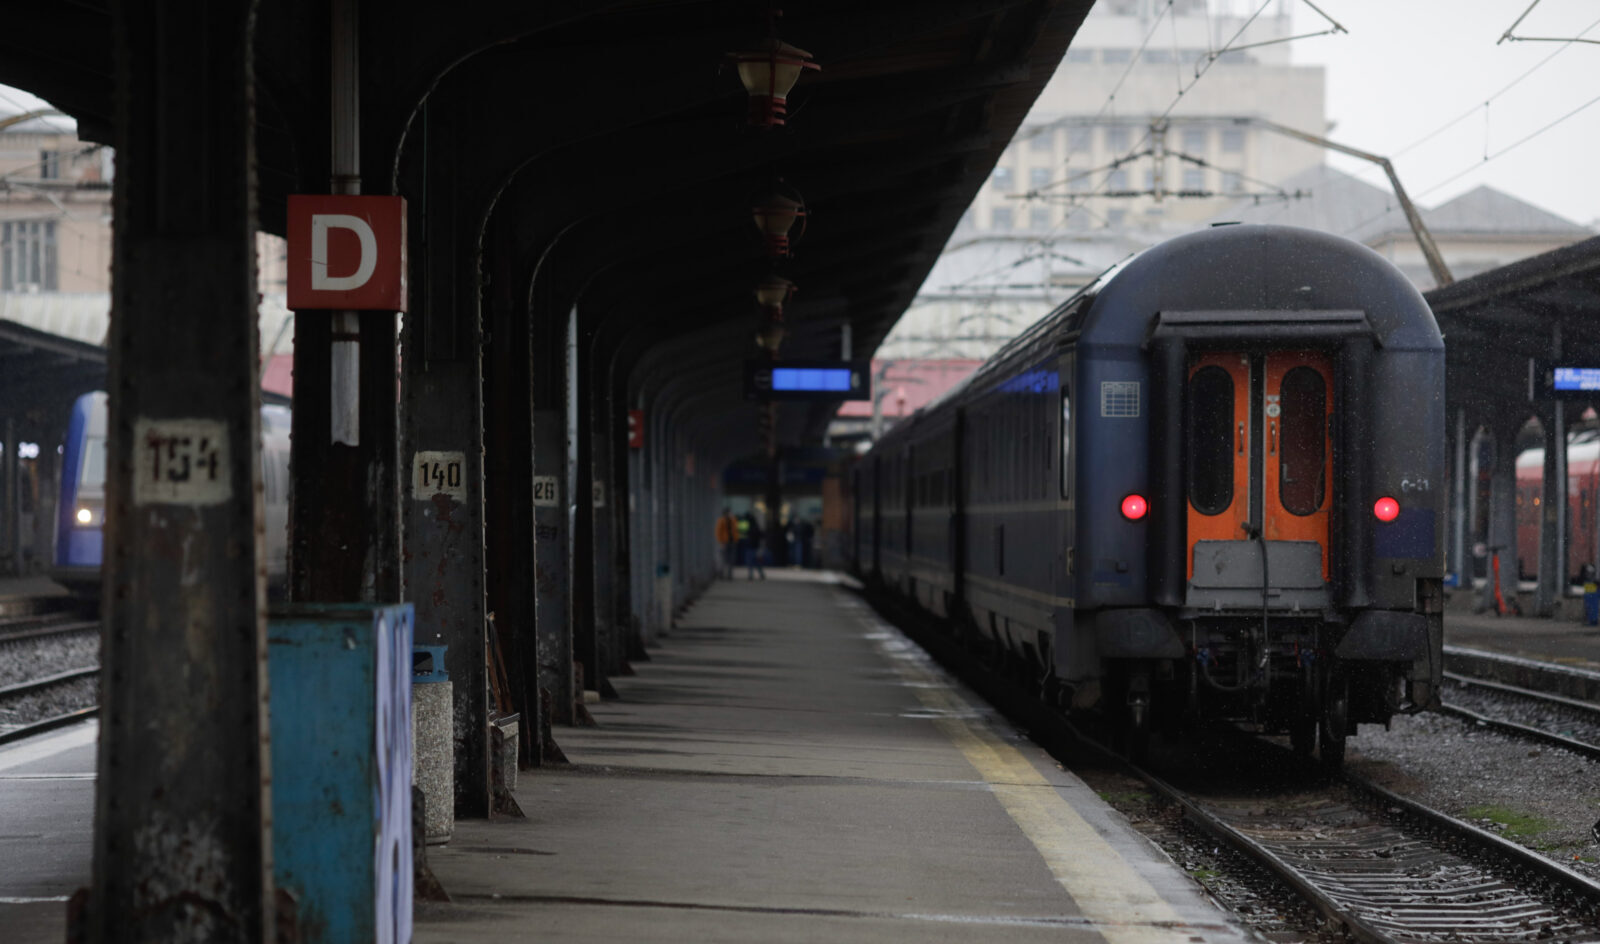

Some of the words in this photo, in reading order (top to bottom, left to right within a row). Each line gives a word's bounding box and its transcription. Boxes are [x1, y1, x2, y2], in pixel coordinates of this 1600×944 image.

[312, 214, 377, 291] D
[146, 430, 217, 482] 154
[420, 462, 460, 487] 140
